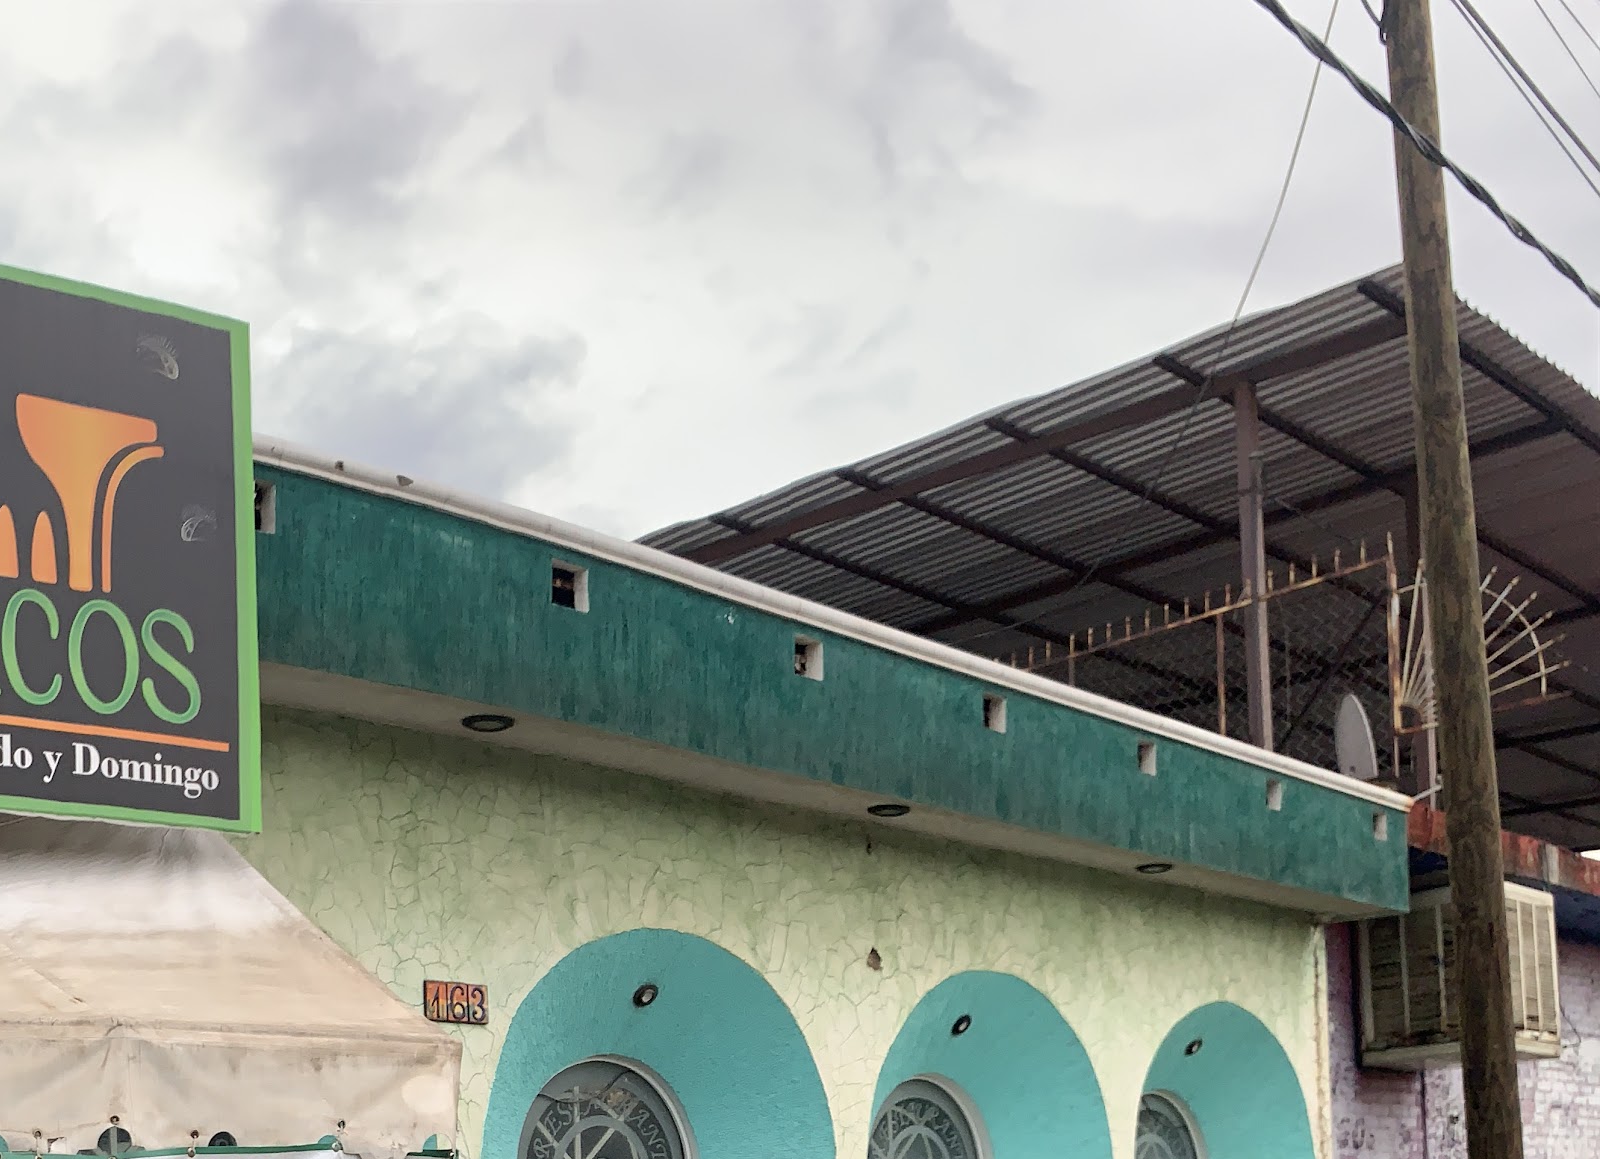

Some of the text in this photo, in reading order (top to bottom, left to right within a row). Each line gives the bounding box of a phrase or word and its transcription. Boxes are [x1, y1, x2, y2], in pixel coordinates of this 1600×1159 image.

[41, 750, 64, 784] y
[72, 742, 221, 799] Domingo
[431, 985, 486, 1021] 163
